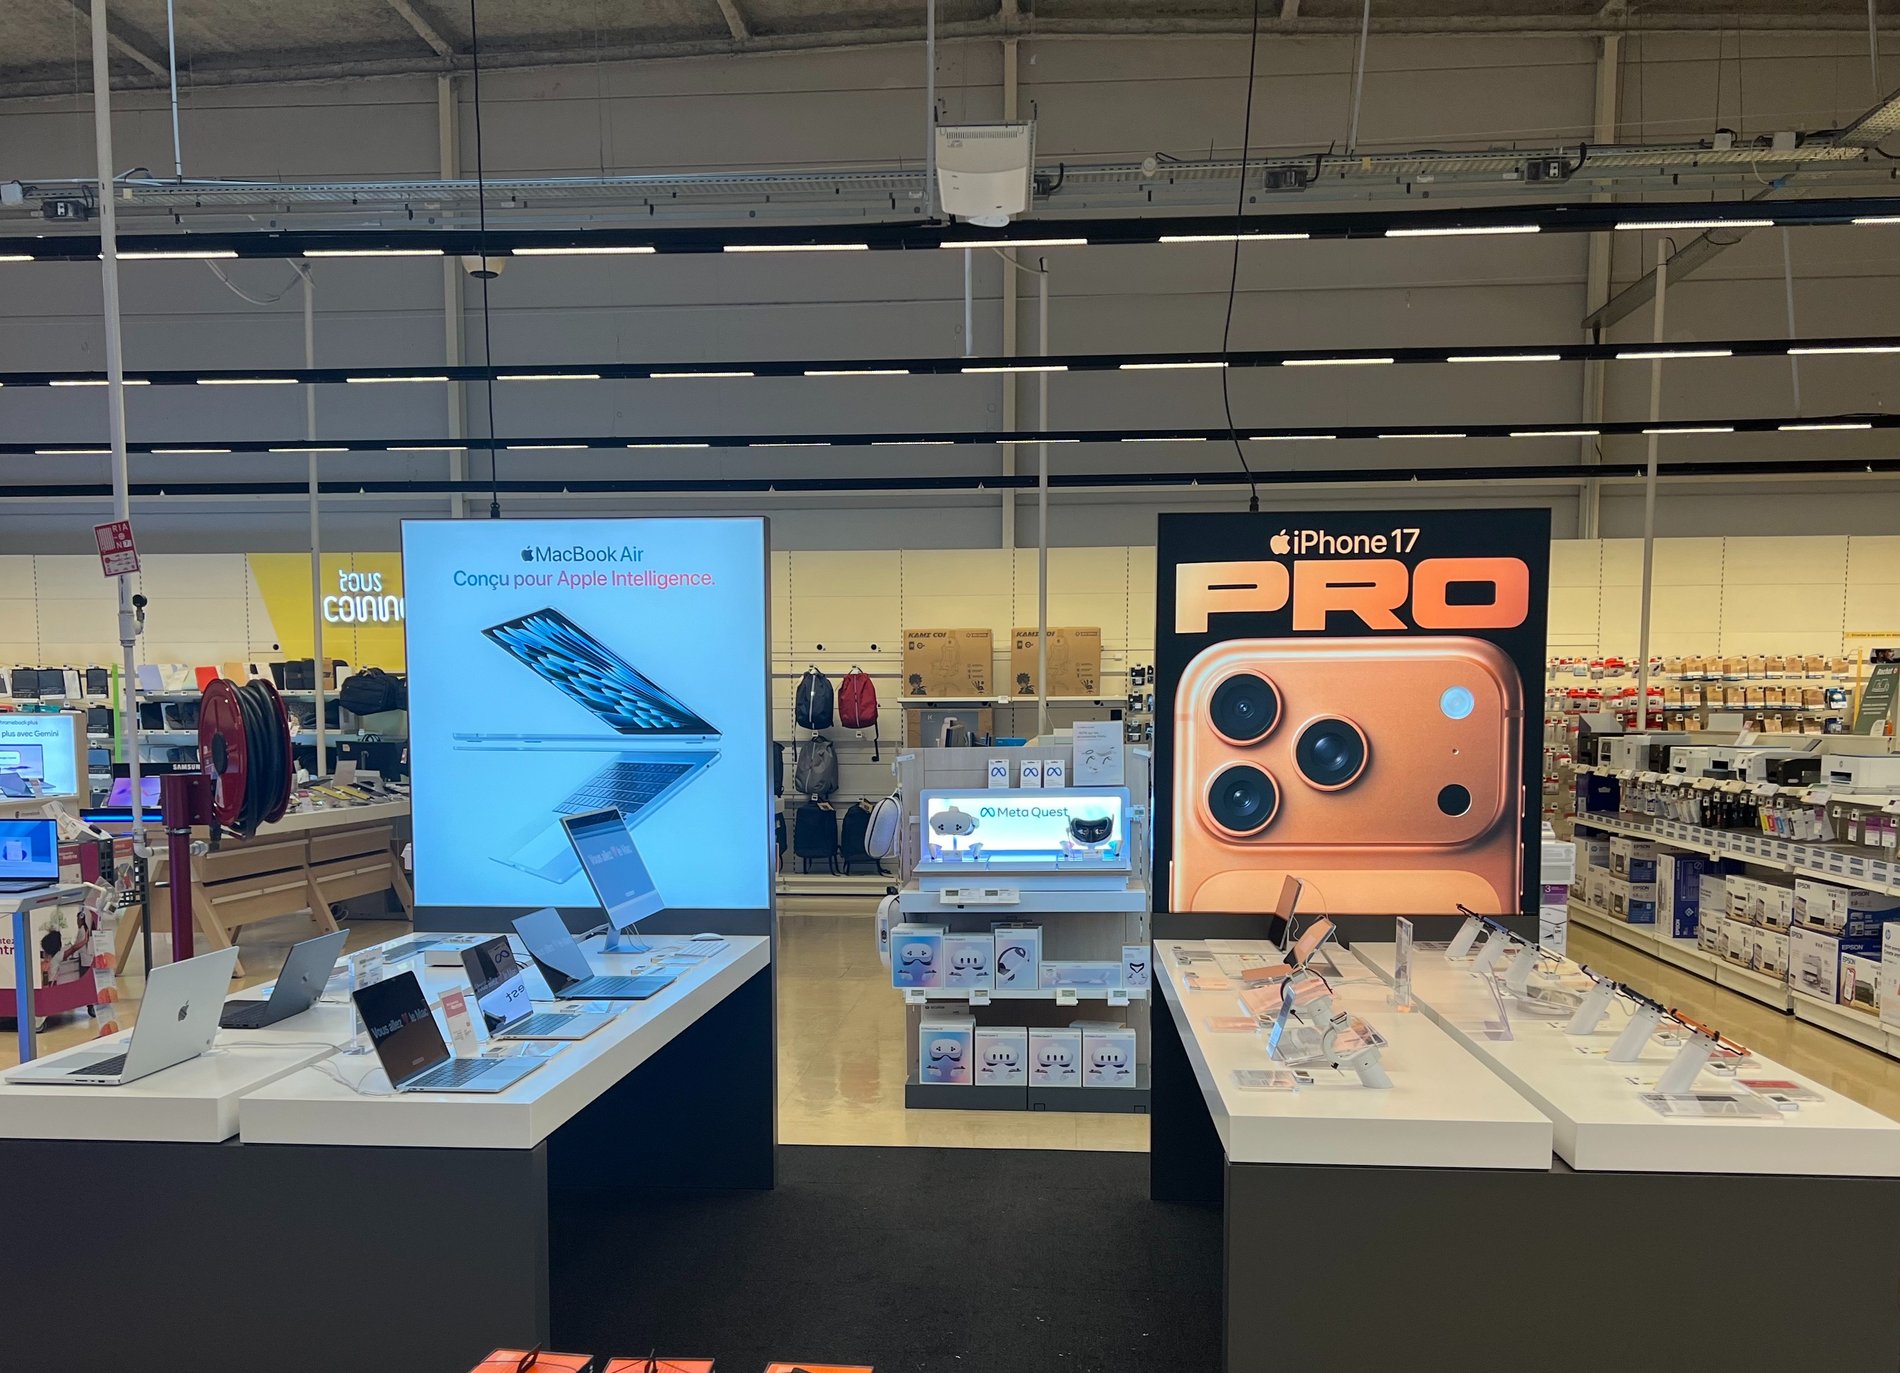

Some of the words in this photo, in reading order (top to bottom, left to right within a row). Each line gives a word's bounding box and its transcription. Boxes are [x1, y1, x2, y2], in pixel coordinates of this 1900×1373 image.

[1293, 529, 1387, 554] iPhone
[1390, 528, 1421, 553] 17
[536, 546, 617, 562] MacBook
[620, 546, 644, 562] Air
[338, 569, 383, 592] tous
[453, 570, 510, 591] Conçu
[514, 573, 552, 590] pour
[557, 570, 608, 590] Apple
[612, 570, 716, 590] Intelligence.
[1175, 557, 1530, 634] PRO
[1, 730, 16, 739] plus
[997, 807, 1029, 817] Meta
[1031, 807, 1068, 818] Quest
[1545, 885, 1551, 893] 3
[371, 1024, 390, 1039] Vous
[388, 1018, 404, 1032] allez
[408, 1012, 417, 1023] le
